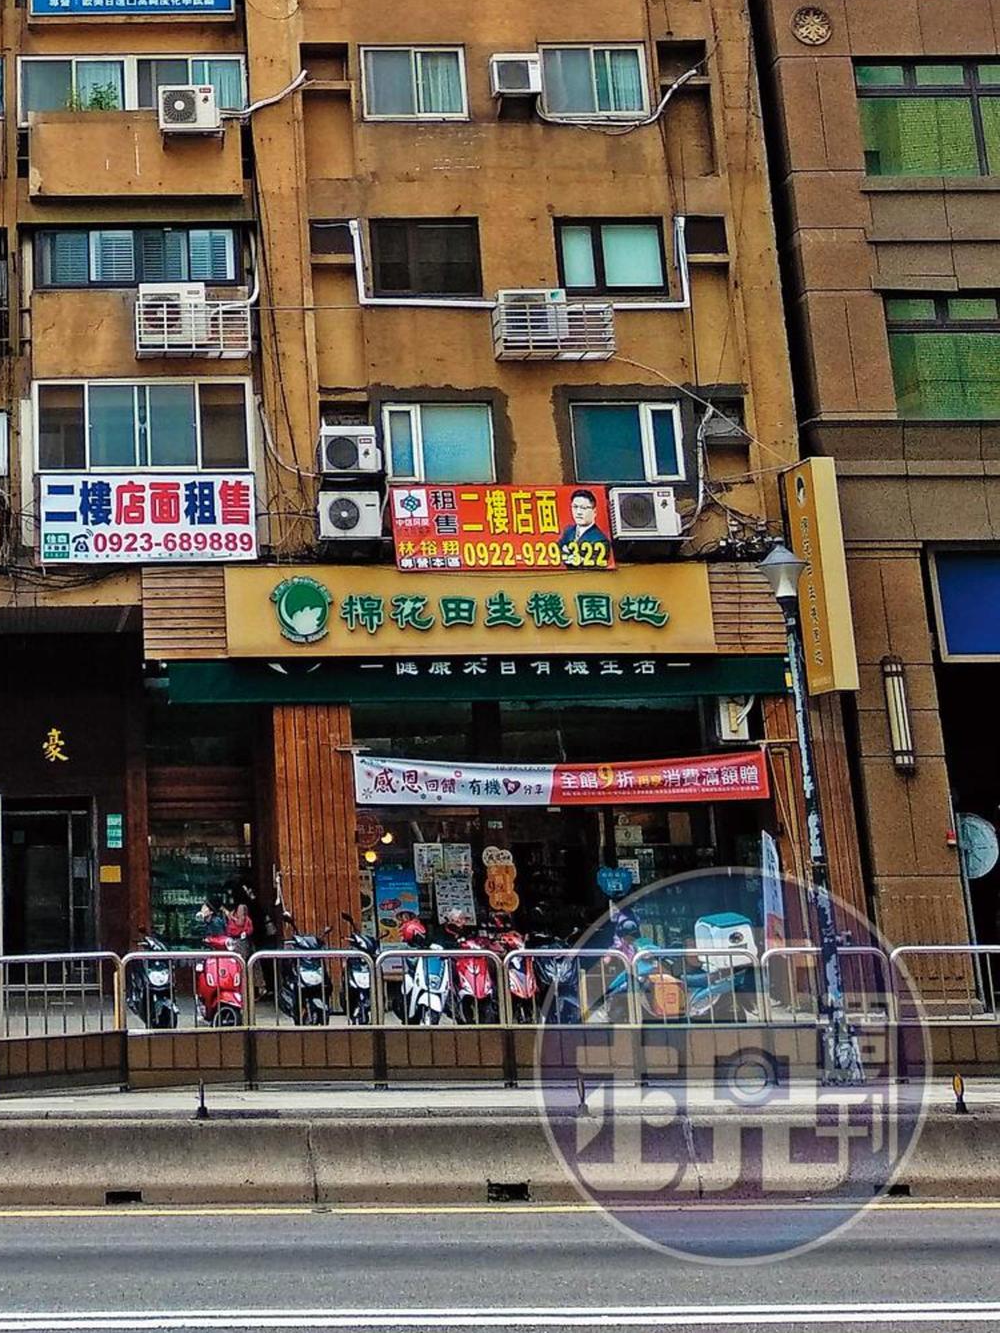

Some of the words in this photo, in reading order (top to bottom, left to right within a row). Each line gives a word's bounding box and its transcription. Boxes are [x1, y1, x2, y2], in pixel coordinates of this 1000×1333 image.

[45, 480, 250, 526] 二樓店面租售
[430, 489, 459, 535] 租售
[460, 489, 561, 535] 二樓店面
[93, 532, 253, 553] 0923-689889
[463, 542, 608, 567] 0922-929-322
[341, 591, 670, 634] 棉花田生機園地
